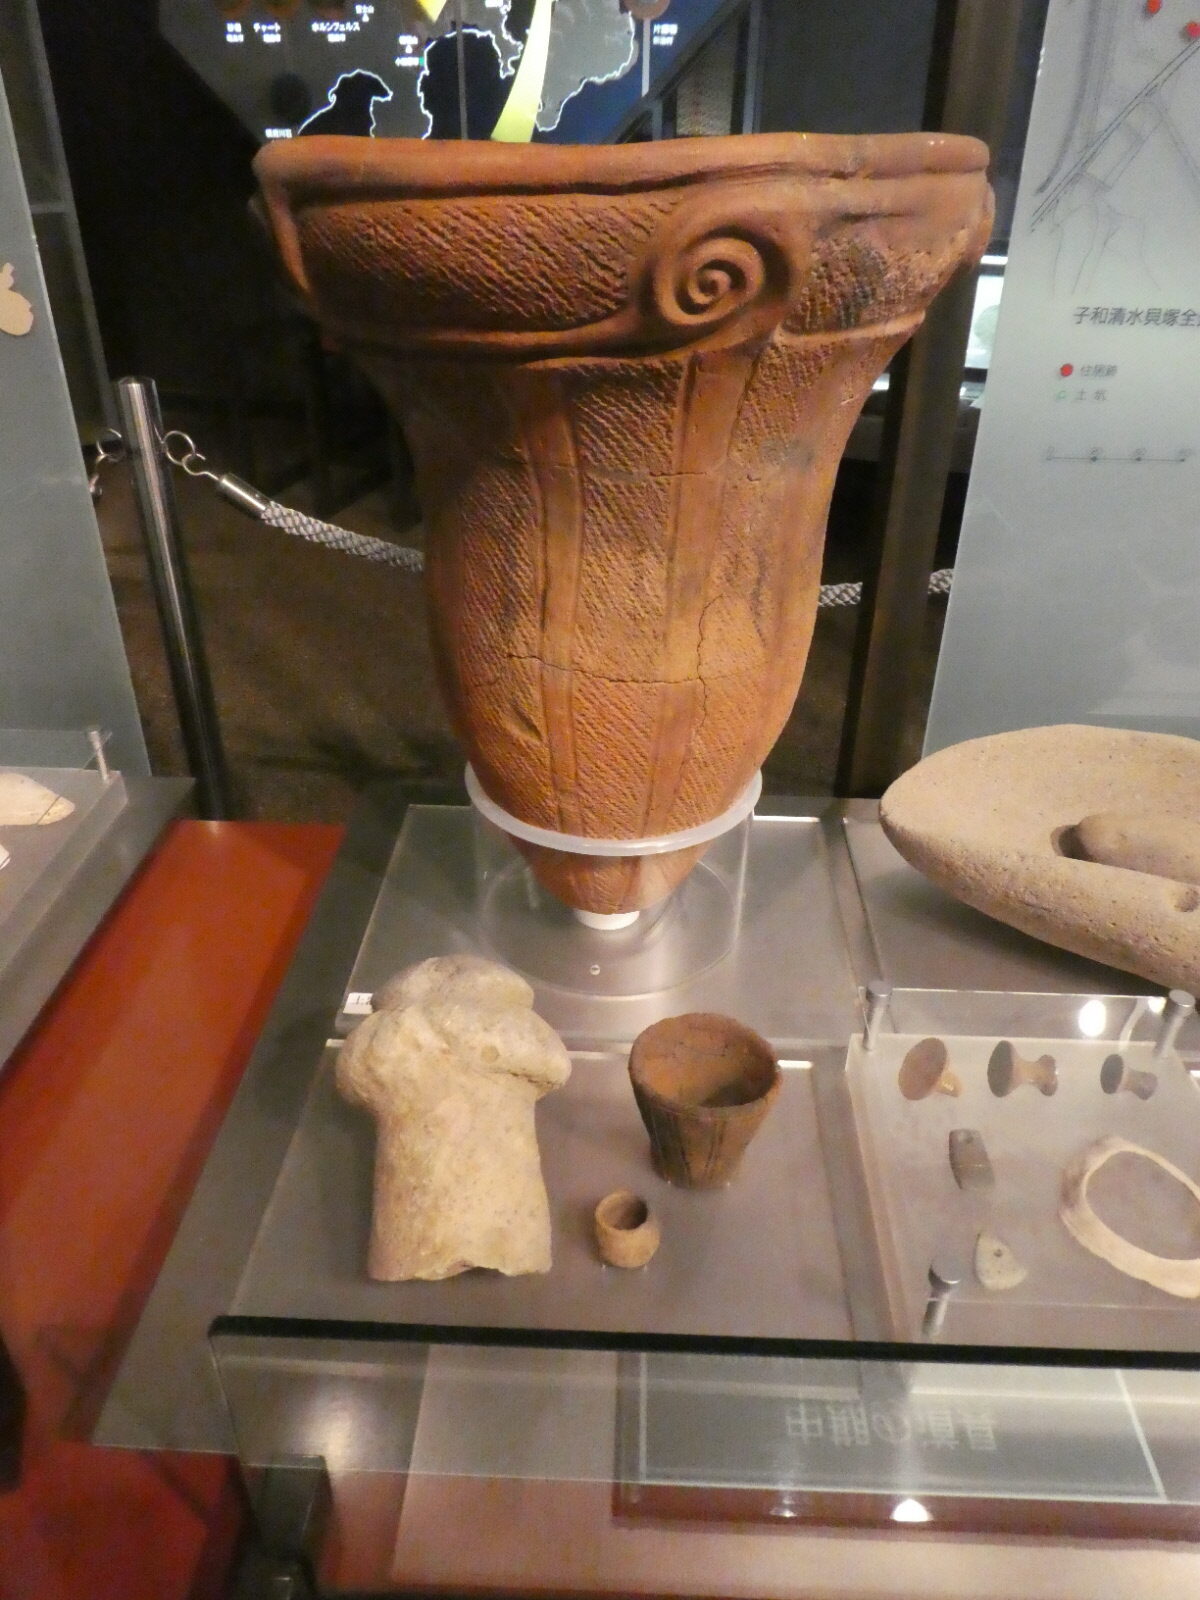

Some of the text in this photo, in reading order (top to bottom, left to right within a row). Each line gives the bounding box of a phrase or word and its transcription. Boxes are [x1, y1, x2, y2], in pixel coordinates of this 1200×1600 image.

[253, 22, 281, 33] チャート
[311, 21, 360, 32] ホルンフェルス
[1073, 306, 1200, 326] 子和清水貝塚全
